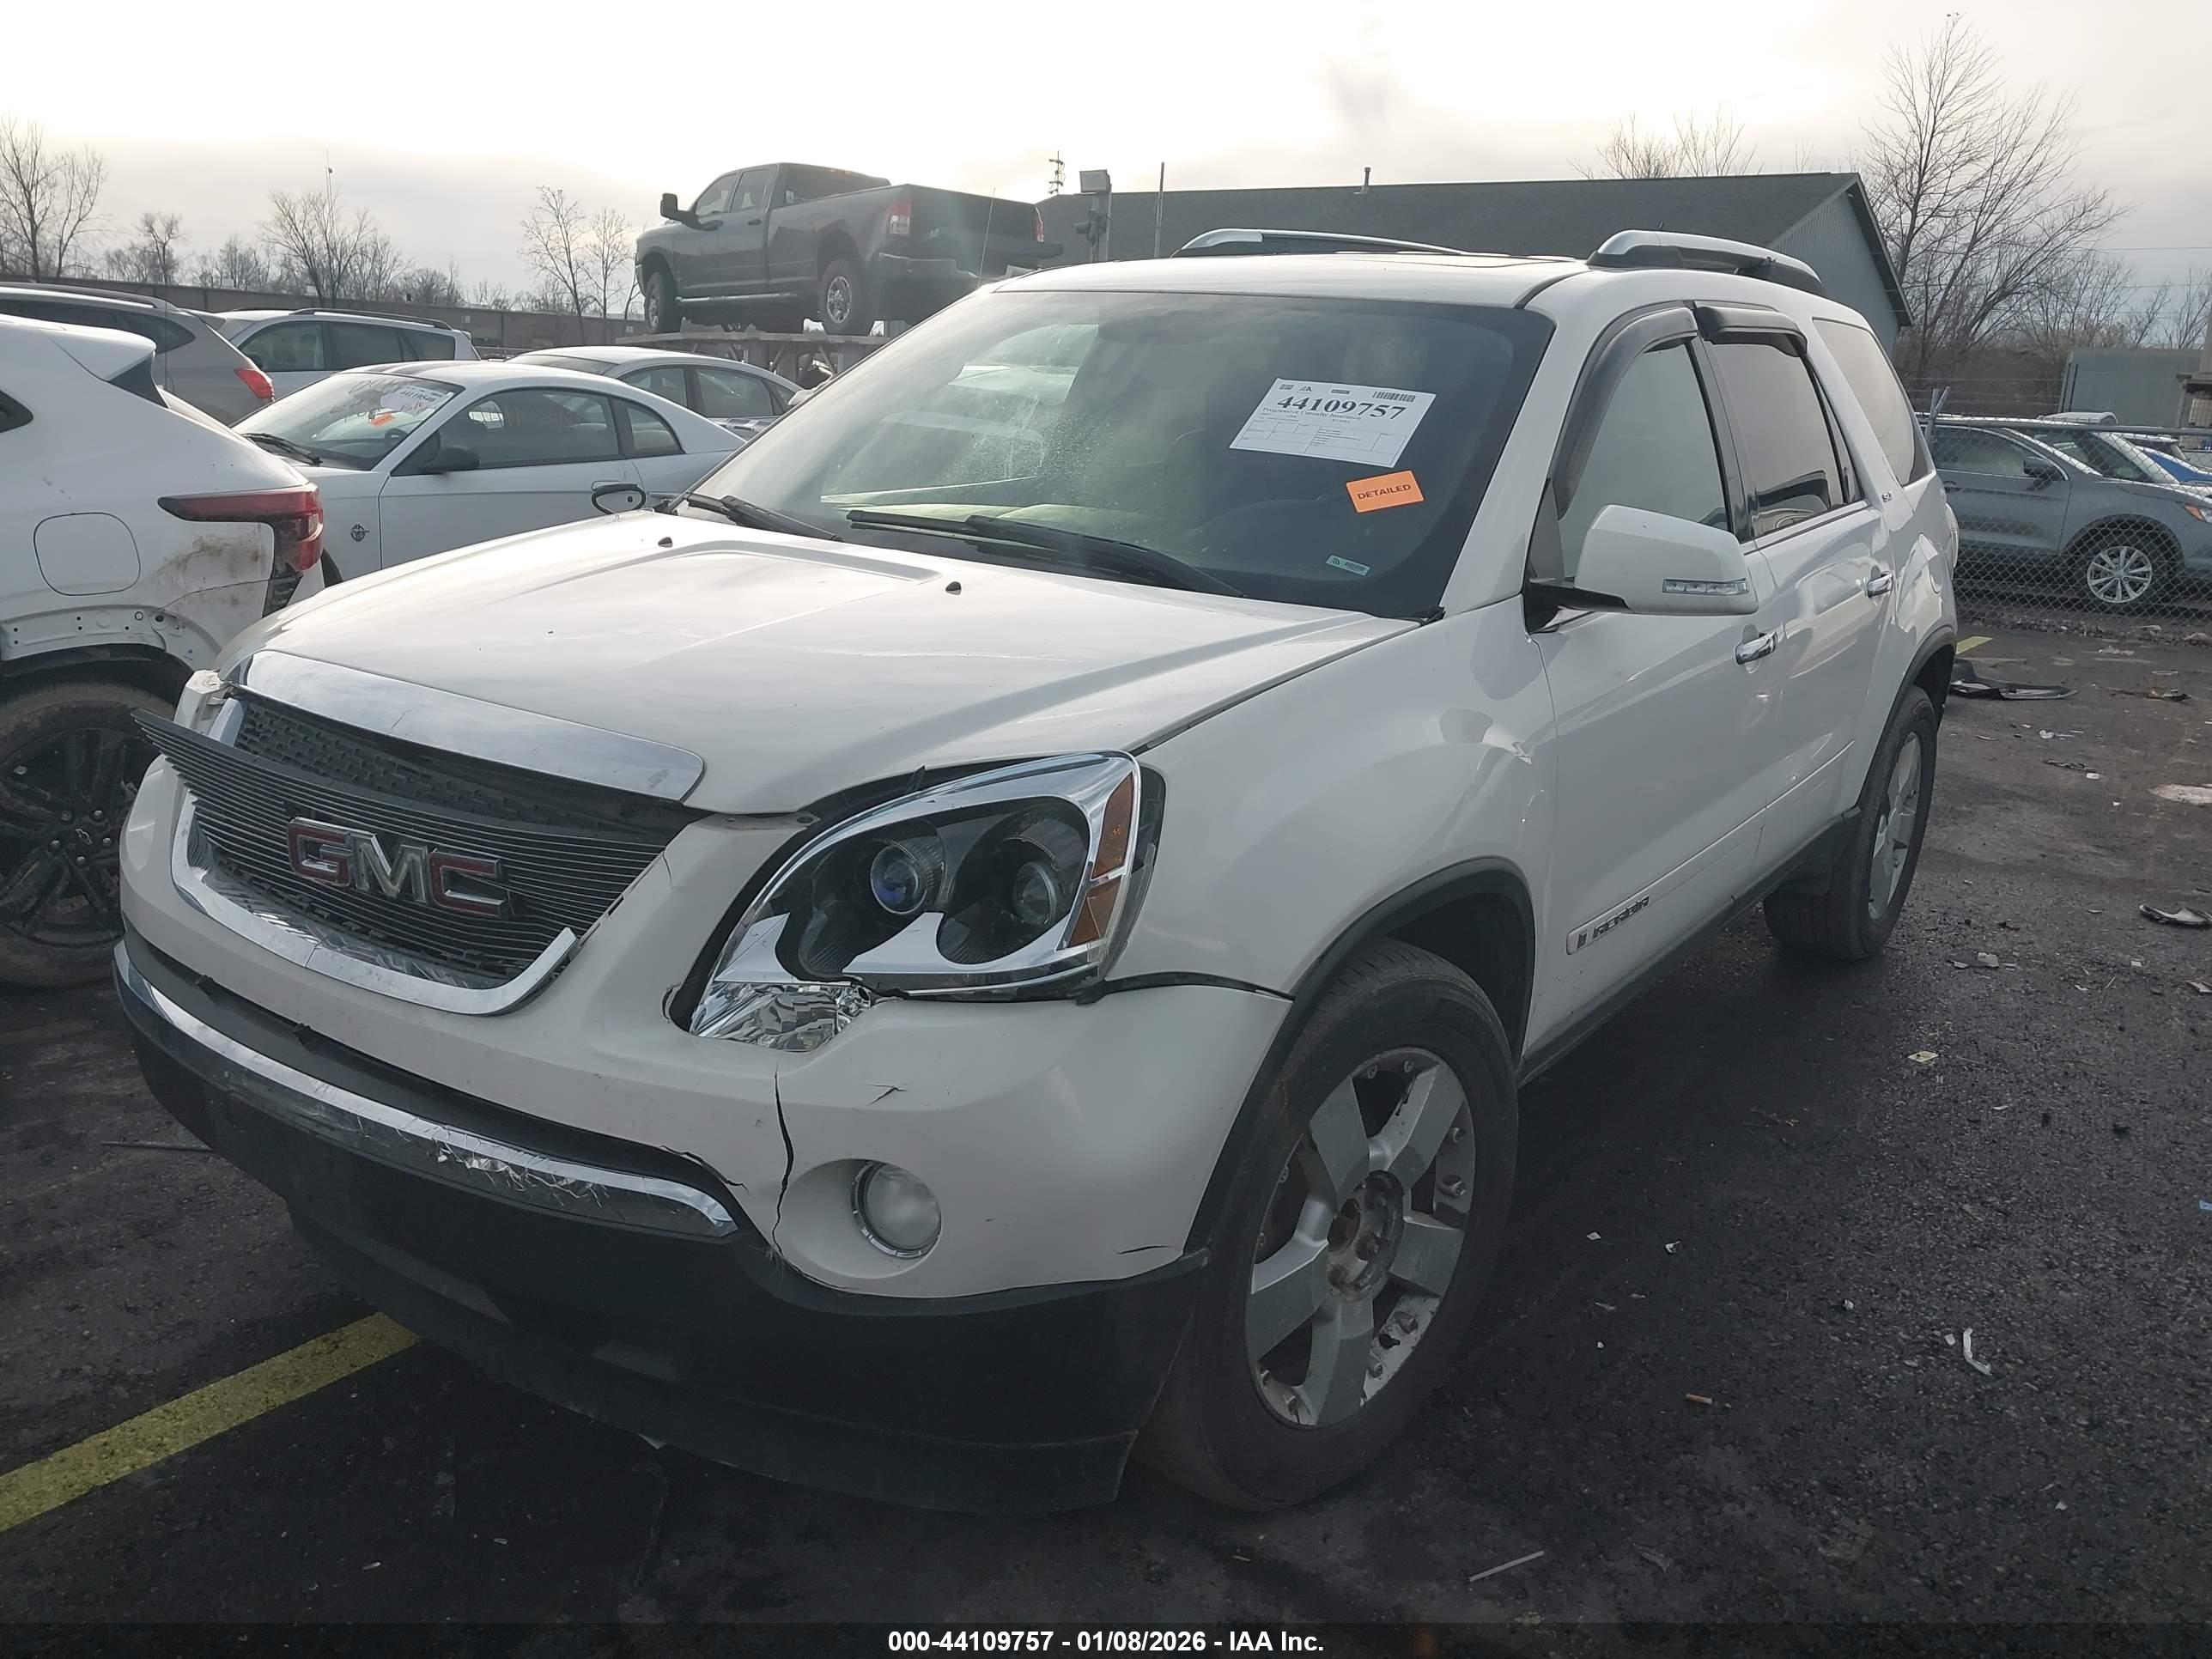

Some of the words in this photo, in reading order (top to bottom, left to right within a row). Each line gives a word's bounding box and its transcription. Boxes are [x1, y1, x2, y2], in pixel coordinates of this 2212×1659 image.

[1277, 395, 1407, 420] 44109757
[1357, 483, 1412, 501] DETAILED
[288, 817, 505, 920] GMC
